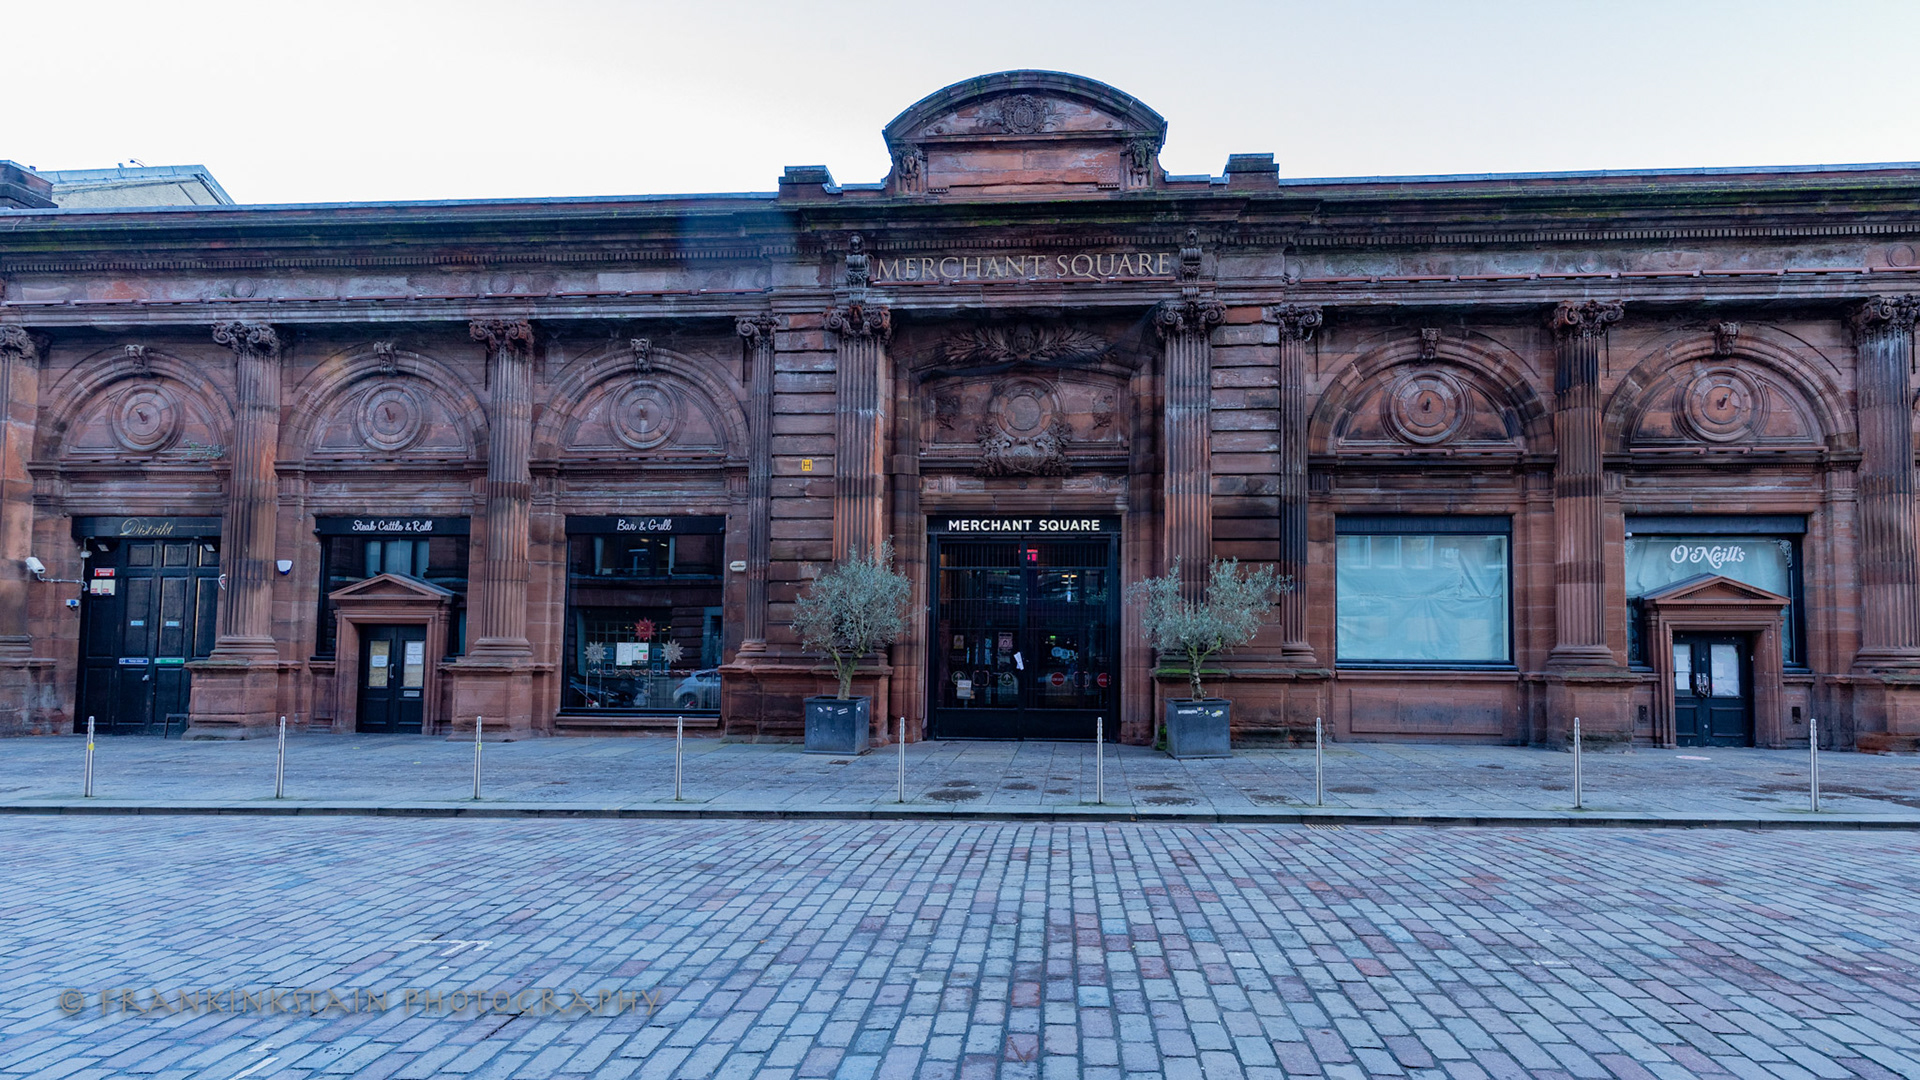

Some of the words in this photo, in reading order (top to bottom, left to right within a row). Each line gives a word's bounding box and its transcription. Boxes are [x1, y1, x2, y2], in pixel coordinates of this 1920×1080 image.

[876, 254, 1046, 280] MERCHANT
[1056, 252, 1171, 281] SQUARE
[120, 517, 173, 535] Distrikt
[352, 519, 376, 531] Steak
[378, 520, 403, 531] Cattle
[405, 522, 412, 531] &
[412, 520, 433, 532] Roll
[616, 518, 637, 531] Bar
[639, 521, 646, 531] &
[648, 518, 672, 531] Grill
[948, 519, 1032, 531] MERCHANT
[1039, 519, 1100, 531] SQUARE
[1670, 544, 1746, 569] O'Neill's
